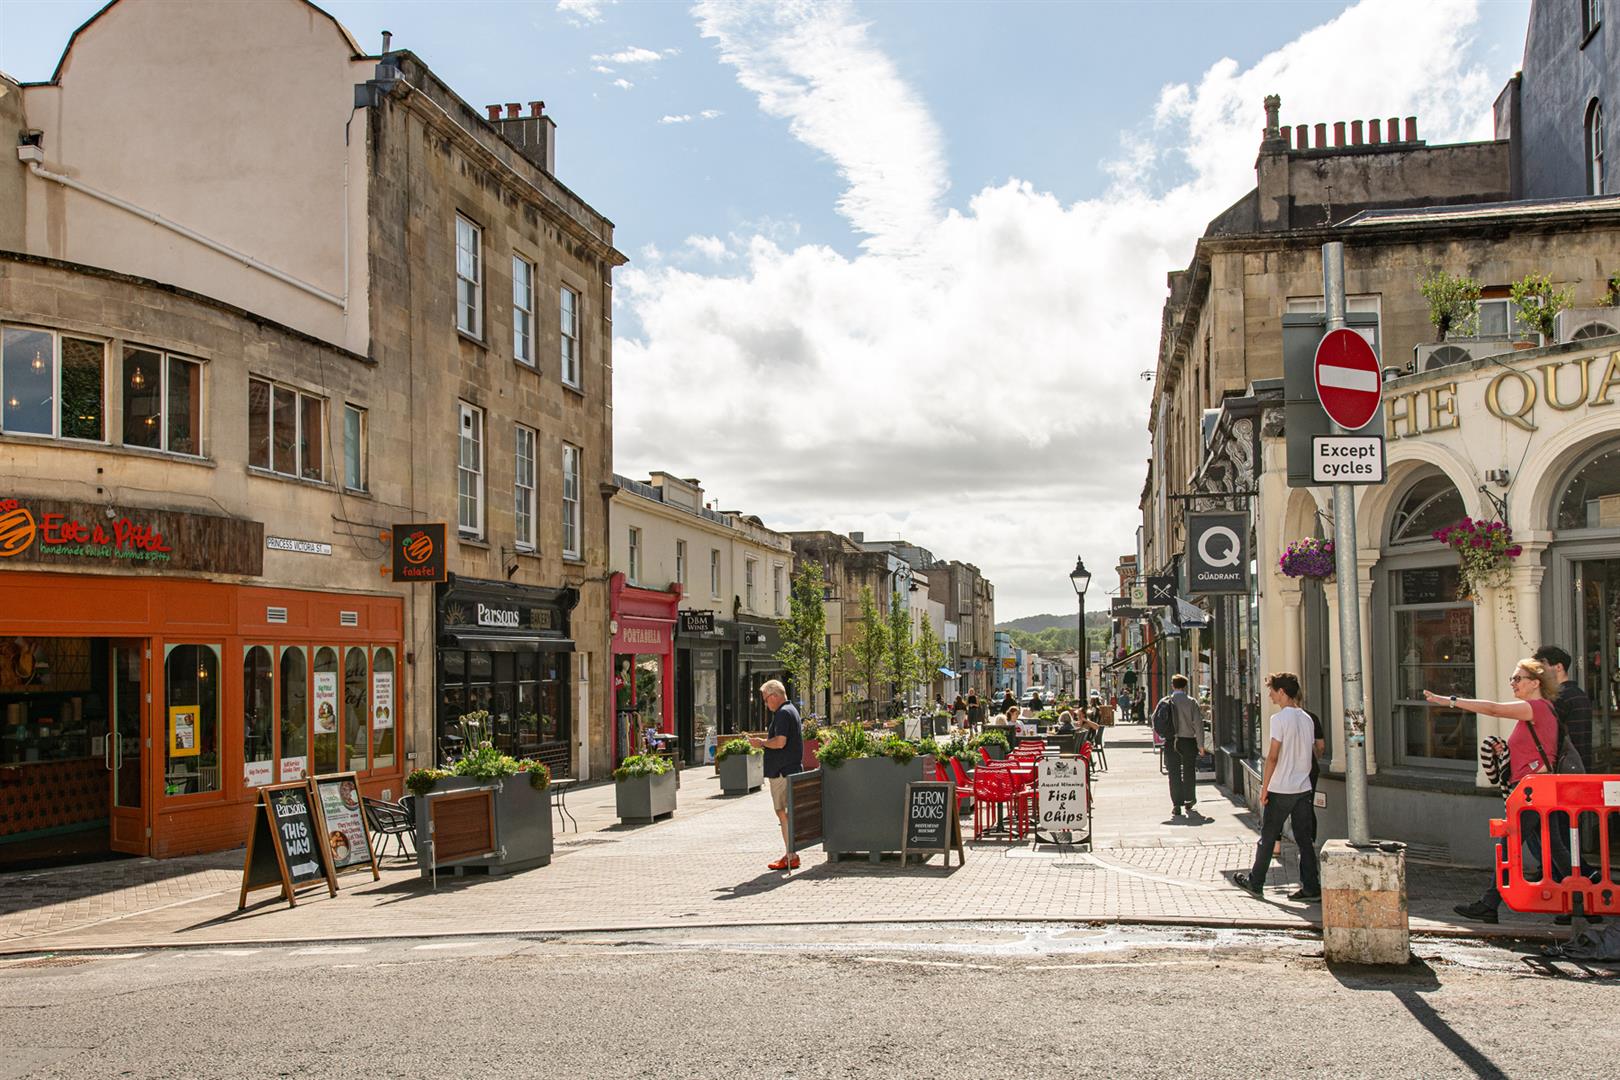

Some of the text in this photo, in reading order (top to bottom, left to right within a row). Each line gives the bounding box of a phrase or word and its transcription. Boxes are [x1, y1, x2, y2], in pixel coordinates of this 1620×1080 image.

[1384, 382, 1460, 442] HE
[1320, 443, 1376, 459] Except
[1322, 460, 1373, 477] cycles
[38, 512, 175, 552] Eat a Pitta
[267, 537, 293, 550] PRINCESS
[293, 541, 315, 552] VICTORIA
[1197, 525, 1241, 567] Q
[404, 565, 435, 577] falafel
[477, 603, 520, 626] Parsons
[687, 617, 708, 625] DBM
[623, 628, 661, 643] PORTABELLA
[912, 791, 945, 805] HERON
[1048, 790, 1076, 801] Fish
[276, 803, 307, 818] Parsons
[911, 805, 944, 819] BOOKS
[1059, 802, 1066, 810] &
[1043, 811, 1083, 824] Chips
[281, 821, 308, 840] THIS
[286, 837, 311, 857] WAY
